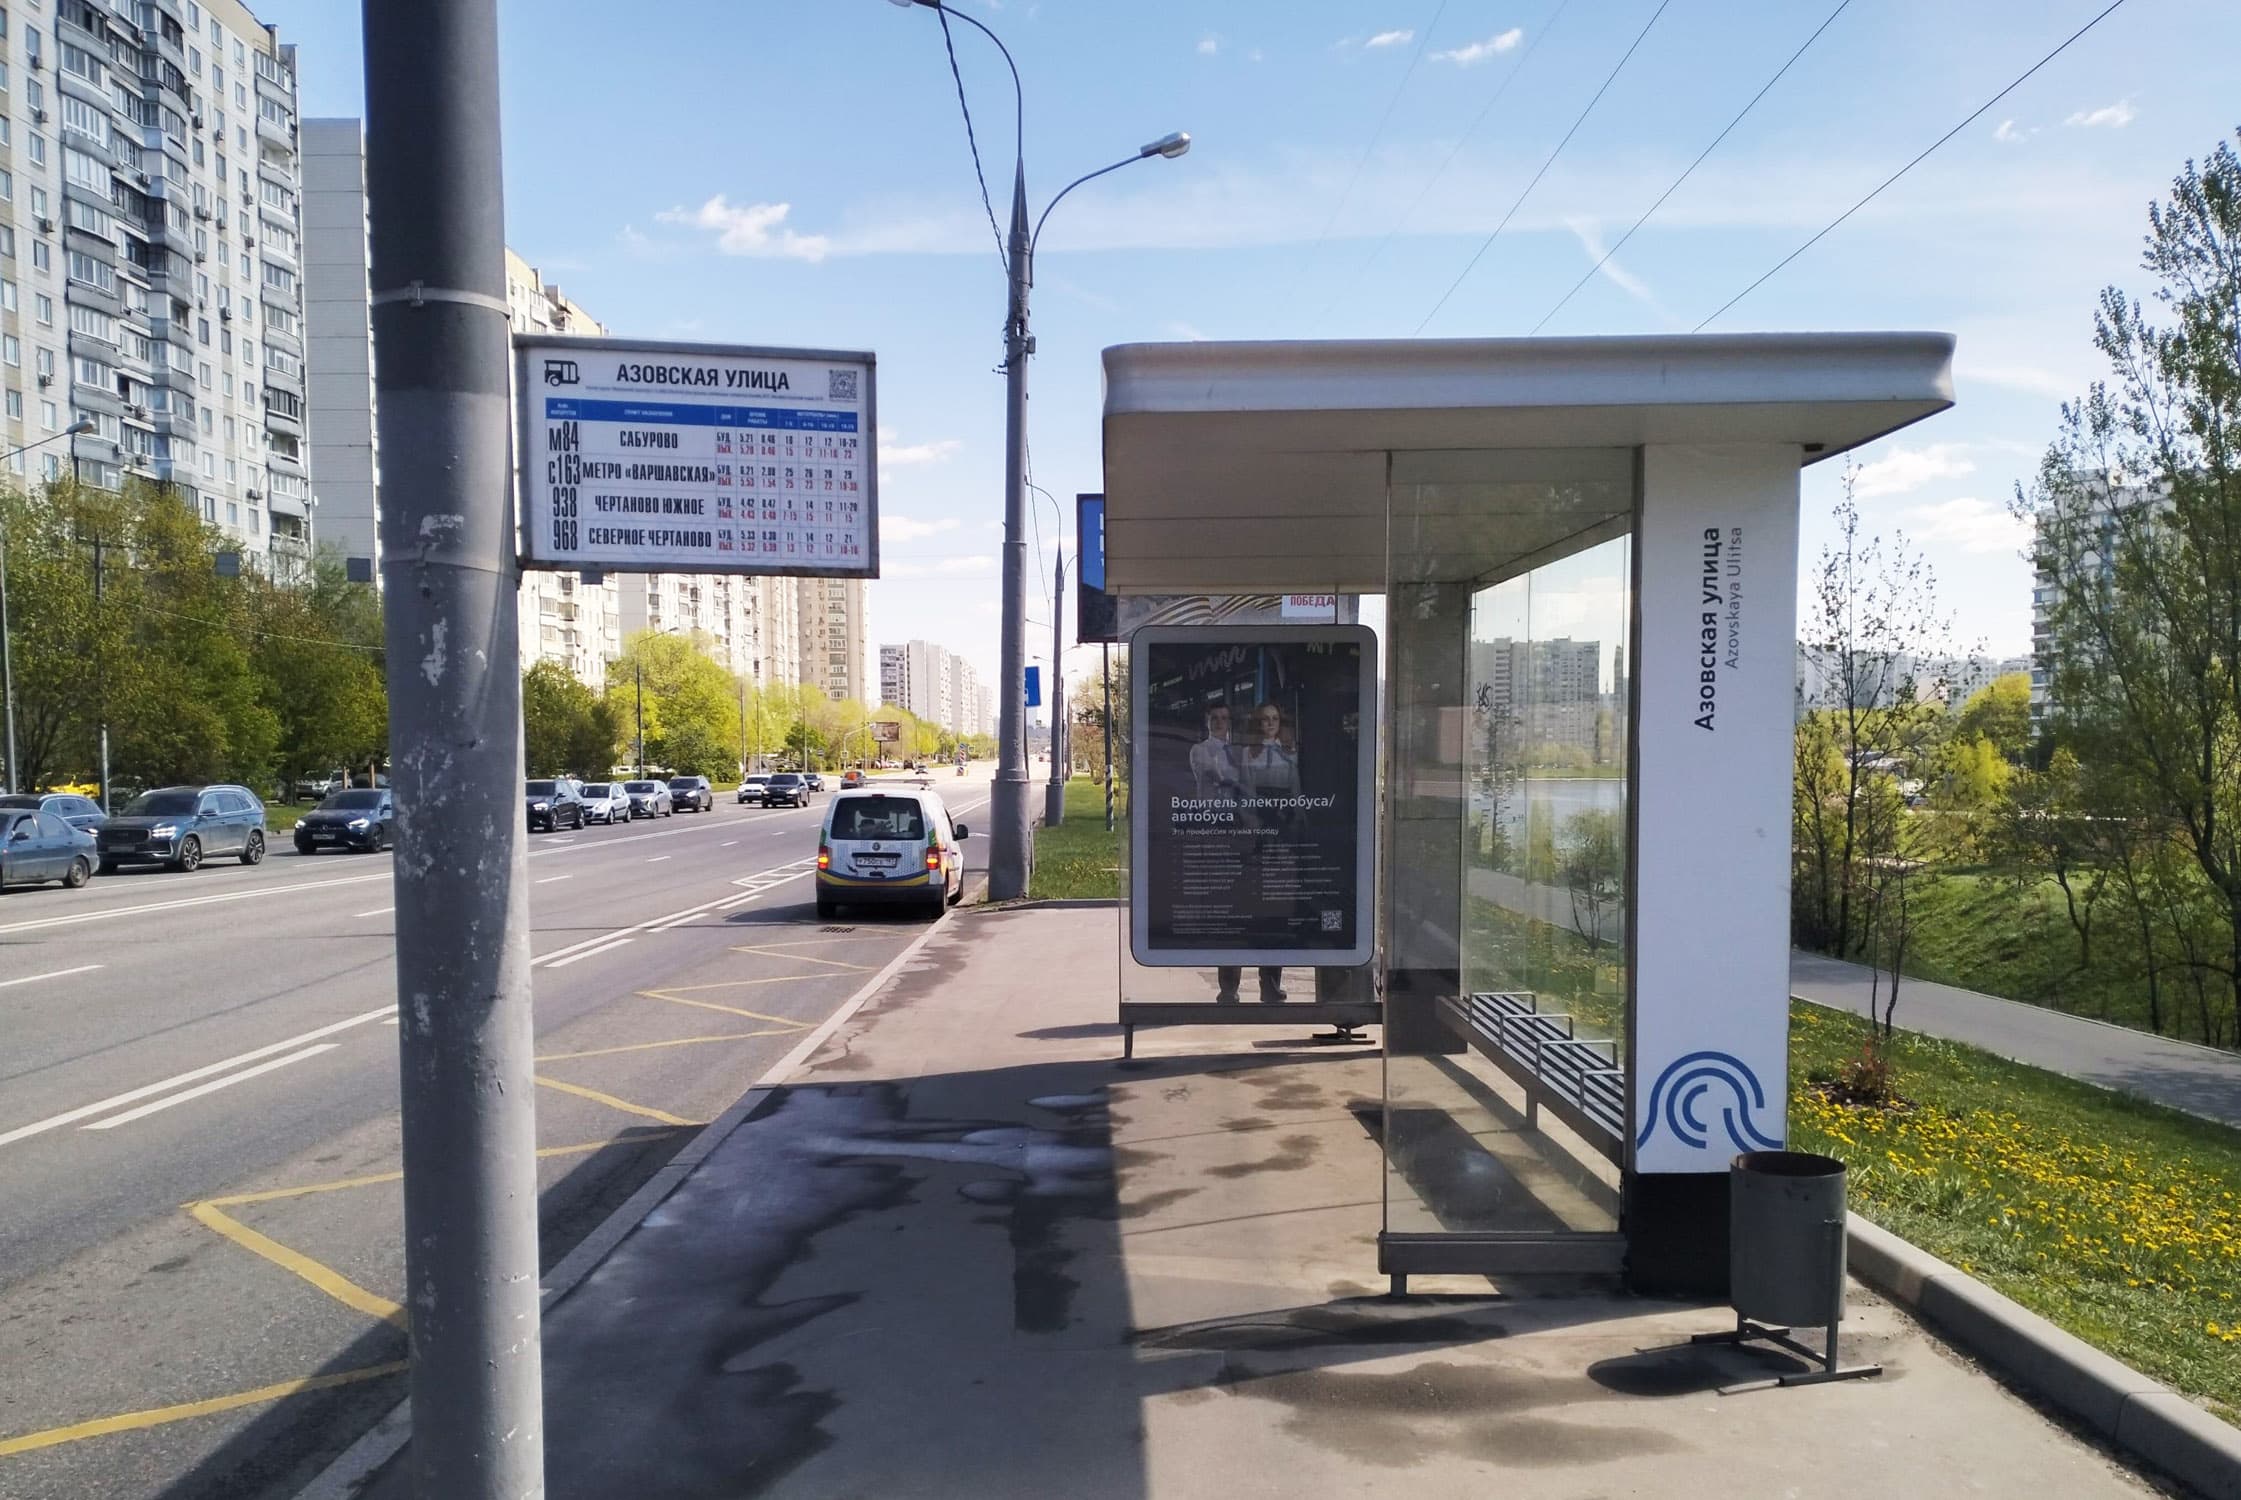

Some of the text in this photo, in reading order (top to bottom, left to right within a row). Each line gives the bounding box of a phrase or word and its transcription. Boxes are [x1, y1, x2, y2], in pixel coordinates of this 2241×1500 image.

[617, 363, 719, 387] АЗОВСКАЯ
[727, 369, 790, 393] УЛИЦА
[620, 430, 679, 449] САБУРОВО
[582, 462, 622, 480] МЕТРО
[625, 463, 715, 483] «ВАРШАВСКАЯ»
[553, 486, 577, 518] 938
[595, 495, 659, 514] ЧЕРТАНОВО
[663, 498, 705, 515] ЮЖНОЕ
[553, 519, 578, 550] 968
[589, 527, 645, 546] СЕВЕРНОЕ
[648, 529, 712, 548] ЧЕРТАНОВО
[1290, 595, 1335, 607] ПОБЕДА
[1724, 527, 1743, 670] Azovskaya Ulitsa
[1694, 527, 1723, 731] Азовская улица
[1171, 794, 1336, 810] Водитель электробуса/
[1171, 810, 1234, 825] автобуса
